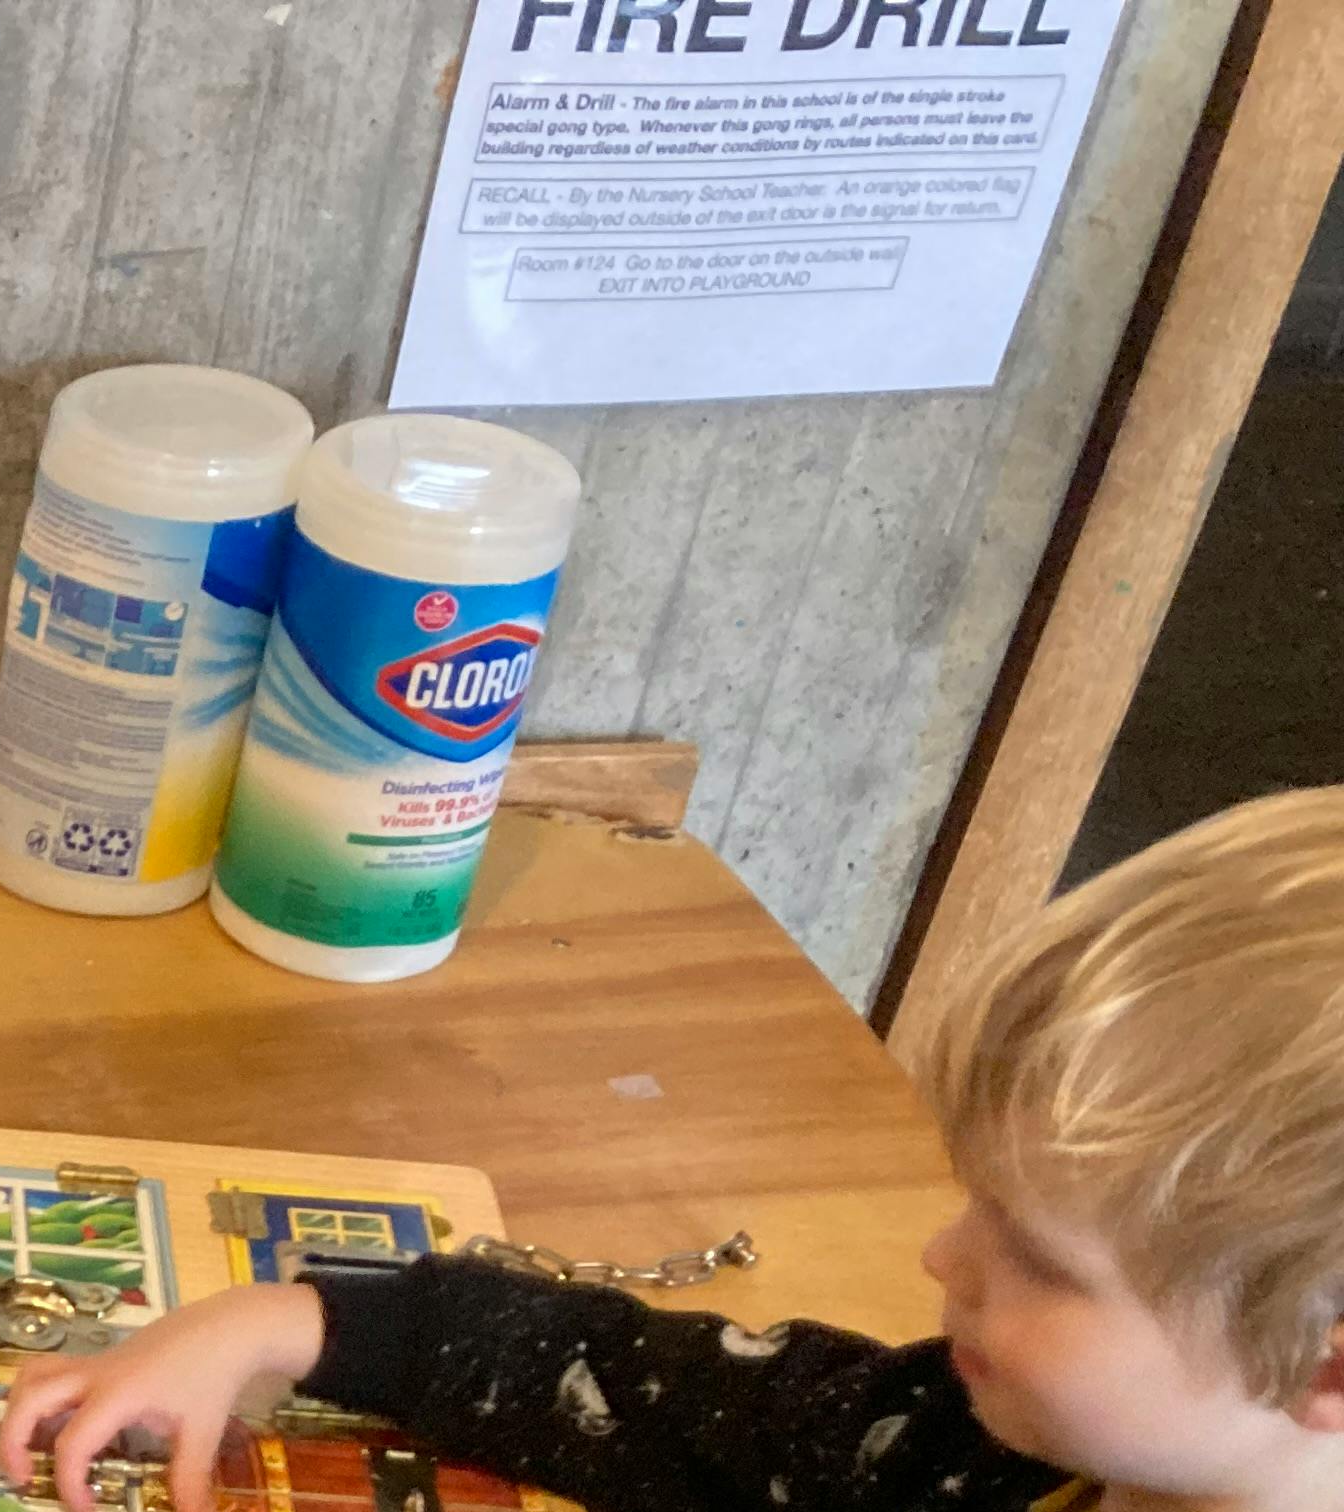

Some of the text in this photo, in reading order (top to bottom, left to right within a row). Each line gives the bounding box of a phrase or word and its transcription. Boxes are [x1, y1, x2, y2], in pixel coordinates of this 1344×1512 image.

[511, 0, 1070, 53] FIRE DRILL
[491, 93, 549, 110] Alarm
[555, 93, 569, 110] &
[576, 93, 616, 110] Drill
[633, 96, 660, 110] The
[665, 96, 690, 110] fire
[694, 95, 738, 110] alarm
[743, 95, 757, 109] in
[761, 94, 787, 109] this
[792, 91, 841, 108] school
[845, 91, 858, 106] is
[862, 90, 878, 105] of
[881, 90, 904, 104] the
[957, 88, 1006, 103] stroke
[486, 120, 544, 135] special
[547, 121, 587, 136] gong
[592, 121, 630, 136] type.
[640, 119, 718, 133] Whenever
[721, 118, 749, 132] this
[752, 119, 790, 134] gong
[839, 113, 858, 127] all
[859, 114, 920, 129] persons
[924, 111, 963, 125] must
[967, 110, 1007, 125] leave
[1010, 111, 1034, 124] the
[481, 142, 544, 158] building
[548, 141, 631, 158] regardless
[635, 141, 653, 154] of
[656, 139, 718, 154] weather
[721, 138, 800, 153] conditions
[803, 137, 821, 152] by
[824, 135, 872, 149] routes
[875, 132, 946, 147] indicated
[948, 133, 968, 146] on
[972, 132, 999, 145] this
[478, 186, 551, 205] RECALL
[569, 186, 592, 206] By
[597, 187, 624, 203] the
[628, 186, 694, 206] Nursery
[698, 184, 757, 202] School
[863, 178, 922, 197] orange
[925, 176, 988, 194] colored
[483, 211, 511, 227] will
[515, 211, 538, 227] be
[542, 211, 624, 230] displayed
[628, 209, 691, 227] outside
[695, 208, 714, 226] of
[717, 208, 743, 224] the
[747, 206, 776, 223] exit
[780, 206, 819, 222] door
[822, 204, 837, 220] is
[841, 203, 867, 218] the
[871, 200, 918, 221] signal
[923, 201, 948, 217] for
[517, 255, 569, 273] Room
[574, 255, 616, 271] #124
[625, 254, 652, 271] Go
[655, 254, 674, 271] to
[677, 253, 703, 270] the
[707, 251, 746, 269] door
[748, 252, 770, 267] on
[774, 250, 800, 265] the
[804, 247, 863, 263] outside
[598, 270, 811, 294] EXIT INTO PLAYGROUND
[381, 778, 475, 795] Disinfecting
[398, 801, 430, 814] Kills
